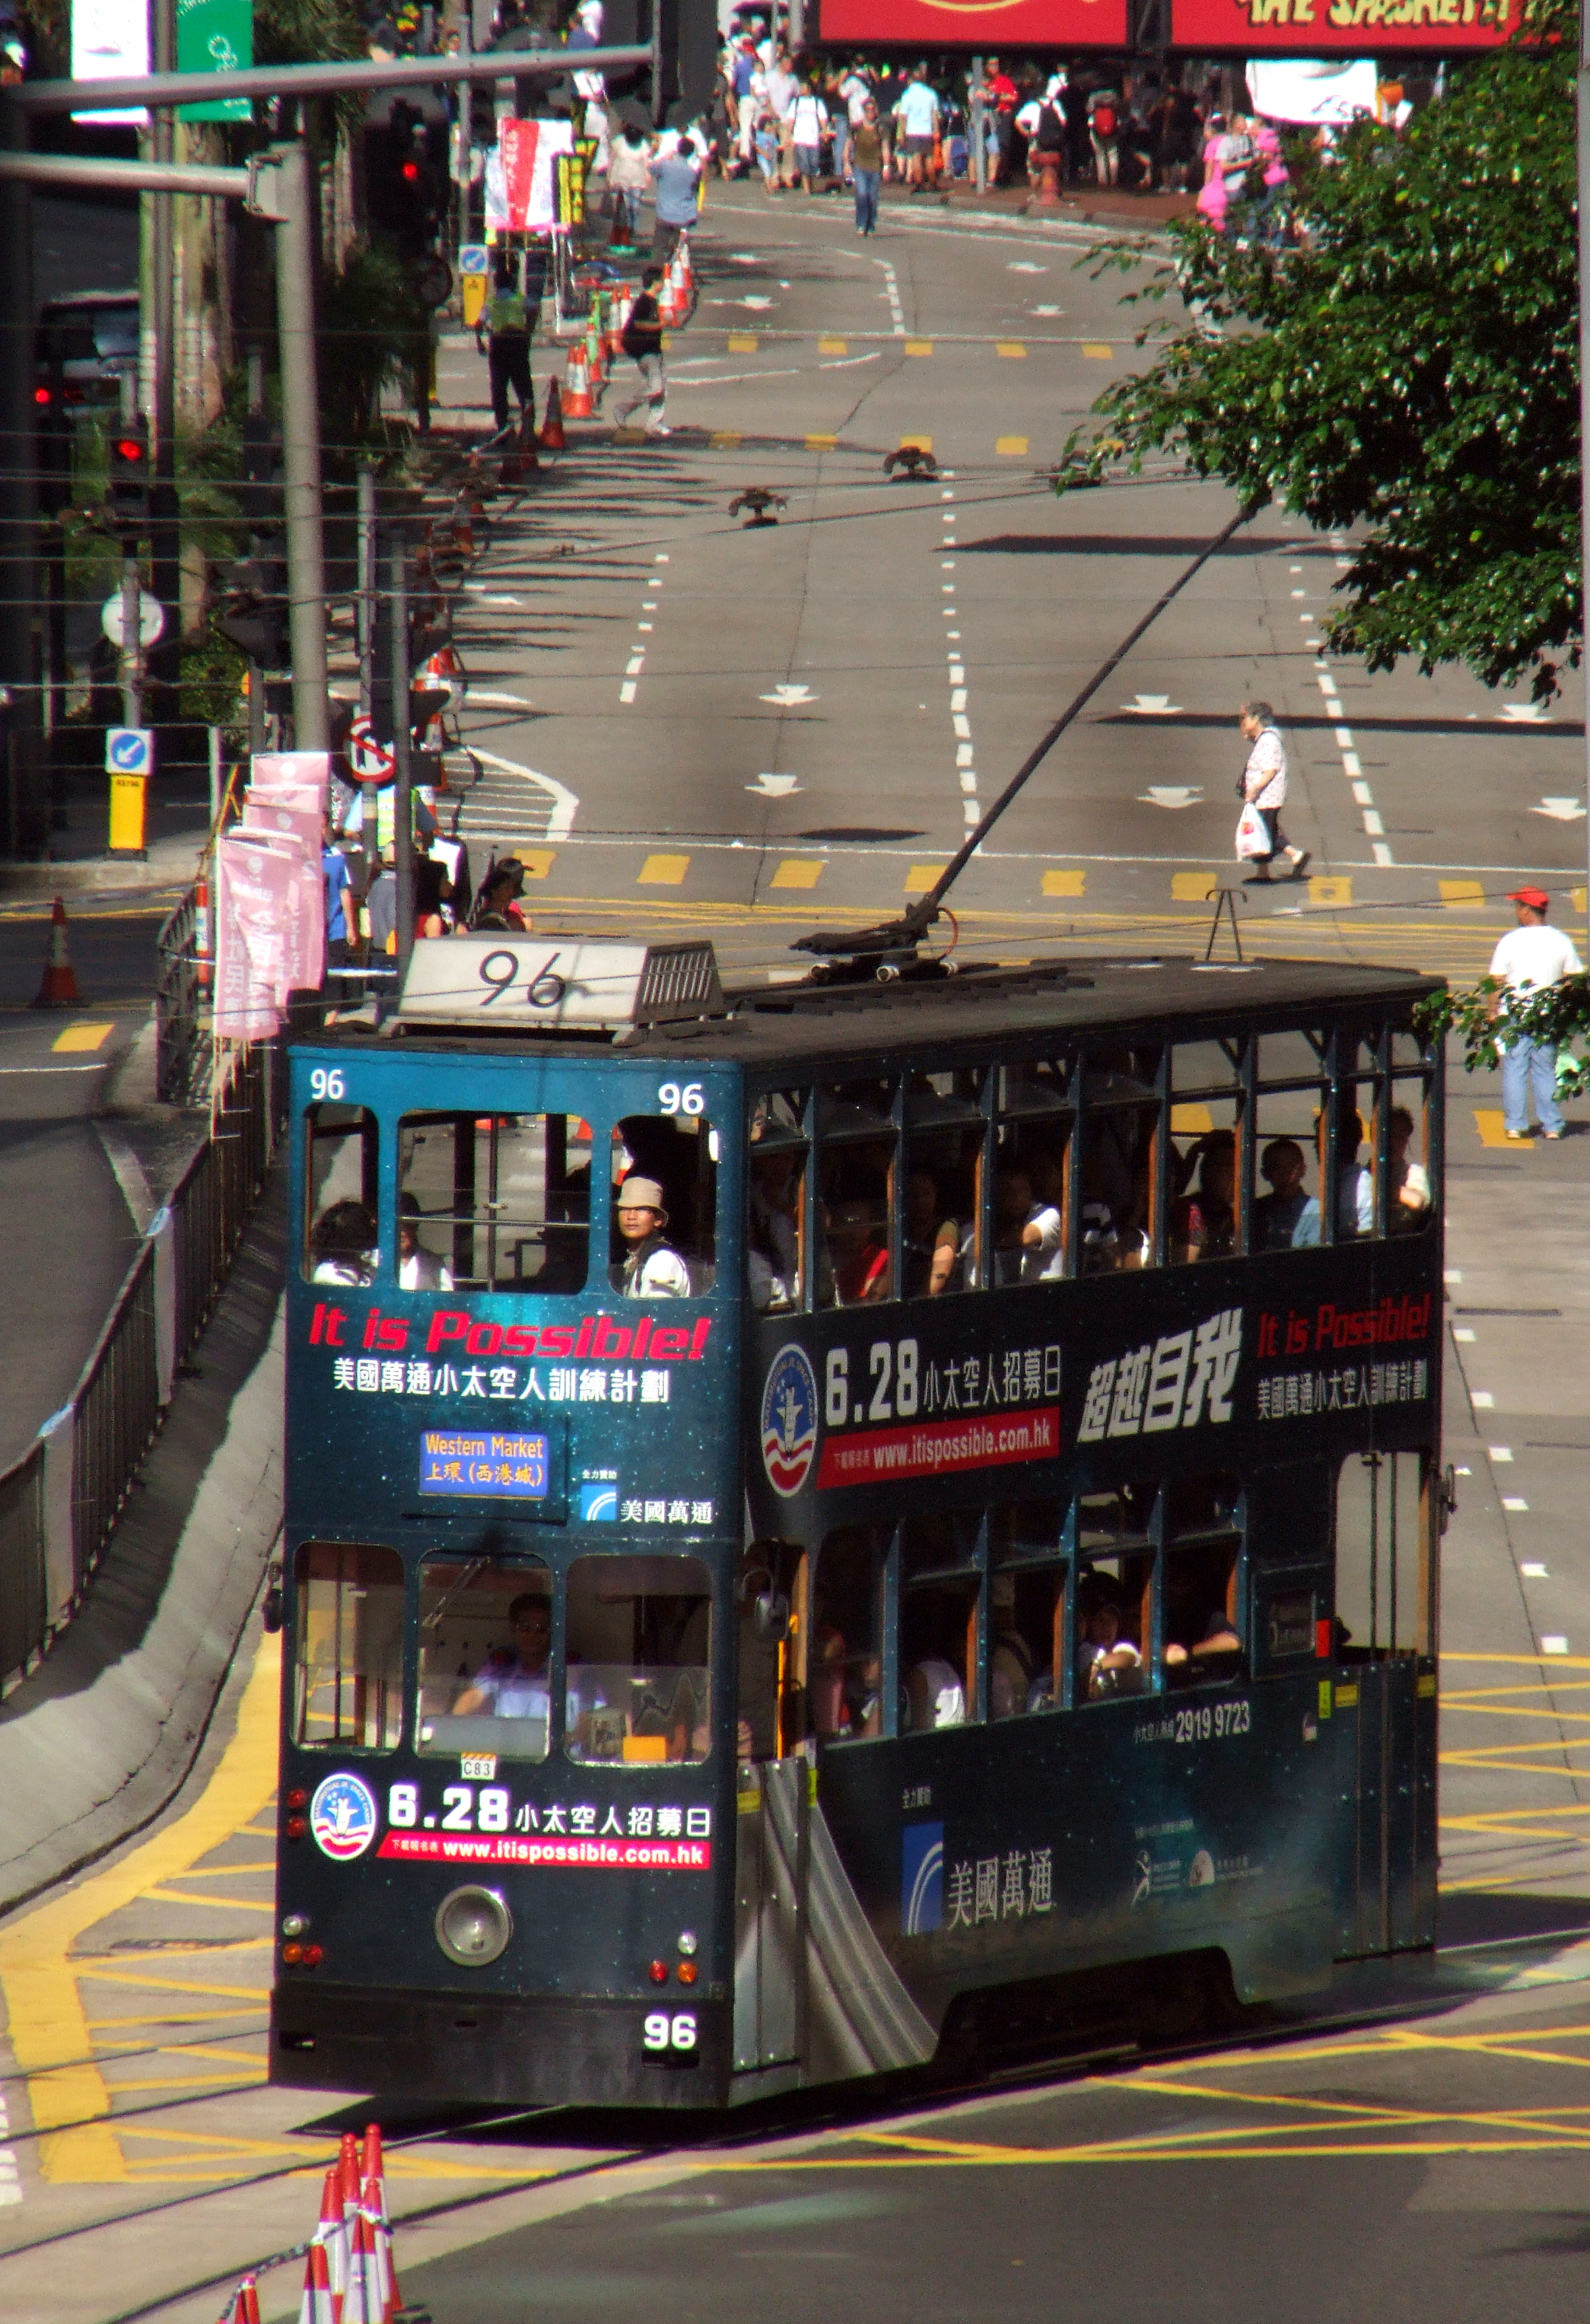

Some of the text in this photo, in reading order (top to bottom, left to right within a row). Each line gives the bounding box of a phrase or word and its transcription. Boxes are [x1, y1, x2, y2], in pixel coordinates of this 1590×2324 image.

[479, 949, 566, 1009] 96
[310, 1068, 344, 1100] 96
[658, 1083, 704, 1114] 96
[308, 1303, 711, 1361] It is Possible!
[1257, 1293, 1431, 1359] It is Possible!
[333, 1357, 669, 1404] 美國萬通小太空人訓練計劃
[825, 1339, 919, 1427] 6.28
[923, 1345, 1061, 1413] 小太空人招募日
[1077, 1307, 1244, 1442] 超越自我
[425, 1433, 544, 1459] Western Market
[873, 1417, 1051, 1469] www.itispossible.com.hk
[621, 1499, 713, 1524] 美國萬通
[1175, 1707, 1211, 1743] 2919
[1214, 1699, 1250, 1737] 9723
[463, 1761, 491, 1776] C83
[389, 1784, 508, 1833] 6.28
[514, 1803, 712, 1838] 小太空人招募日
[442, 1839, 704, 1864] www.itispossible.com.hk
[947, 1848, 1053, 1930] 美國萬通
[644, 2015, 696, 2050] 96
